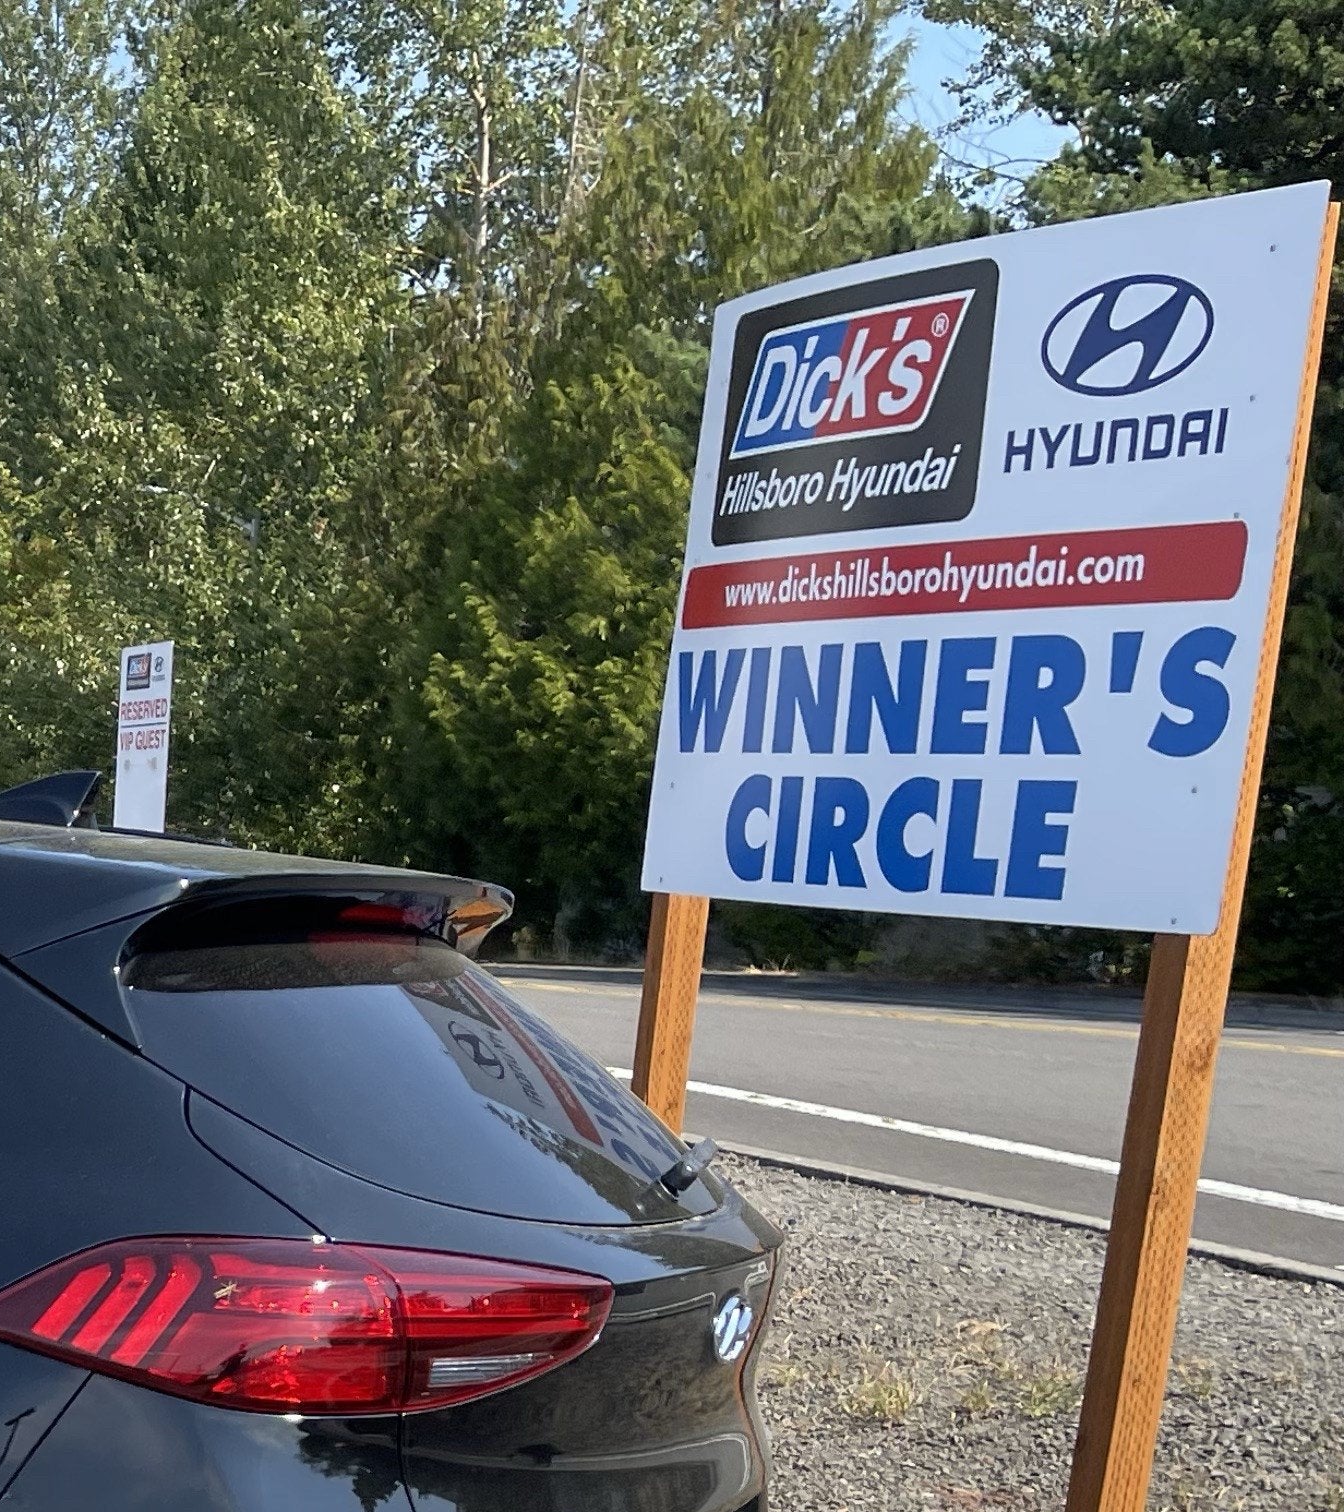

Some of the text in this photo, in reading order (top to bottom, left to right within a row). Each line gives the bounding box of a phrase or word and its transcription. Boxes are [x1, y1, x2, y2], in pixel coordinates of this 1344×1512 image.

[744, 316, 933, 438] Dick's
[1003, 407, 1230, 474] HYUNDAI
[719, 443, 962, 516] Hillsboro Hyundai
[724, 545, 1145, 608] www.dickshillsborohyundai.com
[120, 698, 168, 721] RESERVED
[678, 626, 1238, 758] WINNER'S
[120, 729, 167, 751] VIP GUEST
[725, 774, 1080, 901] CIRCLE
